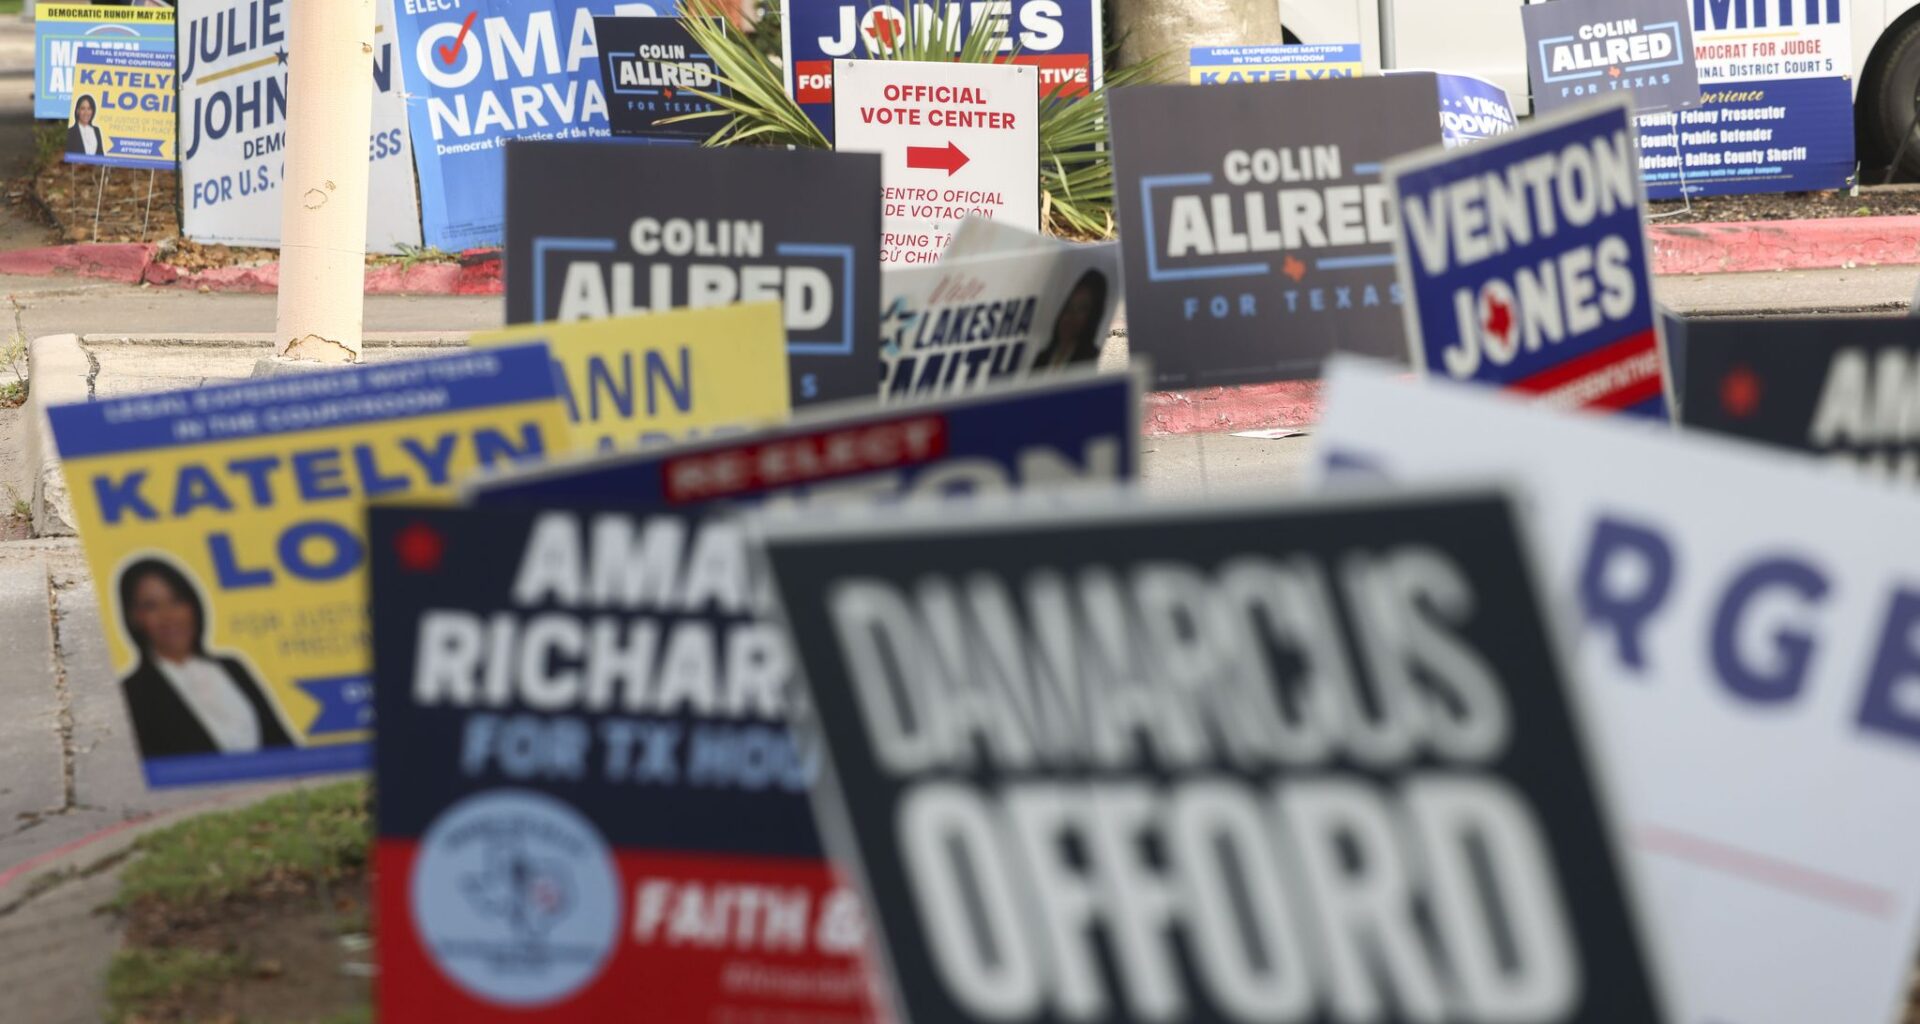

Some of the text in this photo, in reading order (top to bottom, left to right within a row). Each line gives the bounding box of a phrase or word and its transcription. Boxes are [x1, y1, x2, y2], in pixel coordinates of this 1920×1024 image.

[48, 8, 102, 18] DEMOCRATIC
[103, 9, 135, 19] RUNOFF
[136, 10, 153, 19] MAY
[817, 0, 1065, 56] JONES
[1578, 18, 1638, 40] COLIN
[182, 0, 285, 83] JULIE
[416, 3, 658, 89] OMA
[639, 44, 686, 59] COLIN
[1211, 45, 1344, 56] LEGAL EXPERIENCE MATTERS
[1263, 54, 1325, 63] COURTROOM
[1552, 32, 1672, 72] ALLRED
[1694, 39, 1822, 60] MOCRAT FOR JUDGE
[620, 61, 712, 87] ALLRED
[1038, 67, 1088, 84] TIVE
[1561, 73, 1671, 98] FOR TEXAS
[1699, 66, 1724, 78] INAL
[1825, 58, 1833, 72] 5
[427, 79, 609, 140] NARVA
[627, 101, 712, 113] FOR TEXAS
[883, 84, 987, 105] OFFICIAL
[1700, 90, 1765, 105] perience
[860, 107, 1016, 129] VOTE CENTER
[1640, 111, 1678, 127] County
[1681, 108, 1718, 125] Felony
[1721, 106, 1786, 122] Prosecutor
[437, 138, 493, 156] Democrat
[556, 128, 569, 139] of
[571, 127, 587, 138] the
[588, 126, 612, 137] Peac
[1641, 133, 1679, 148] County
[1681, 130, 1718, 145] Public
[1720, 128, 1773, 144] Defender
[1685, 151, 1722, 167] Dallas
[1723, 149, 1765, 165] County
[1766, 146, 1807, 162] Sheriff
[1223, 145, 1342, 186] COLIN
[193, 175, 232, 210] FOR
[239, 165, 275, 196] U.S.
[943, 189, 1004, 205] OFICIAL
[1403, 130, 1636, 275] VENTON
[885, 204, 906, 217] DE
[1167, 183, 1398, 258] ALLRED
[629, 216, 764, 258] COLIN
[1183, 285, 1407, 321] FOR TEXAS
[1442, 234, 1637, 382] JONES
[914, 296, 1037, 349] LAKESHA
[880, 341, 1026, 393] MITH
[91, 423, 549, 525] KATELYN
[207, 519, 366, 590] LO
[512, 510, 746, 614] AMA
[413, 606, 794, 721] RICHAR
[826, 544, 1517, 777] DAMARCUS
[461, 711, 822, 792] FOR TX HOU
[633, 877, 806, 953] FAITH
[897, 770, 1583, 1024] OFFORD
